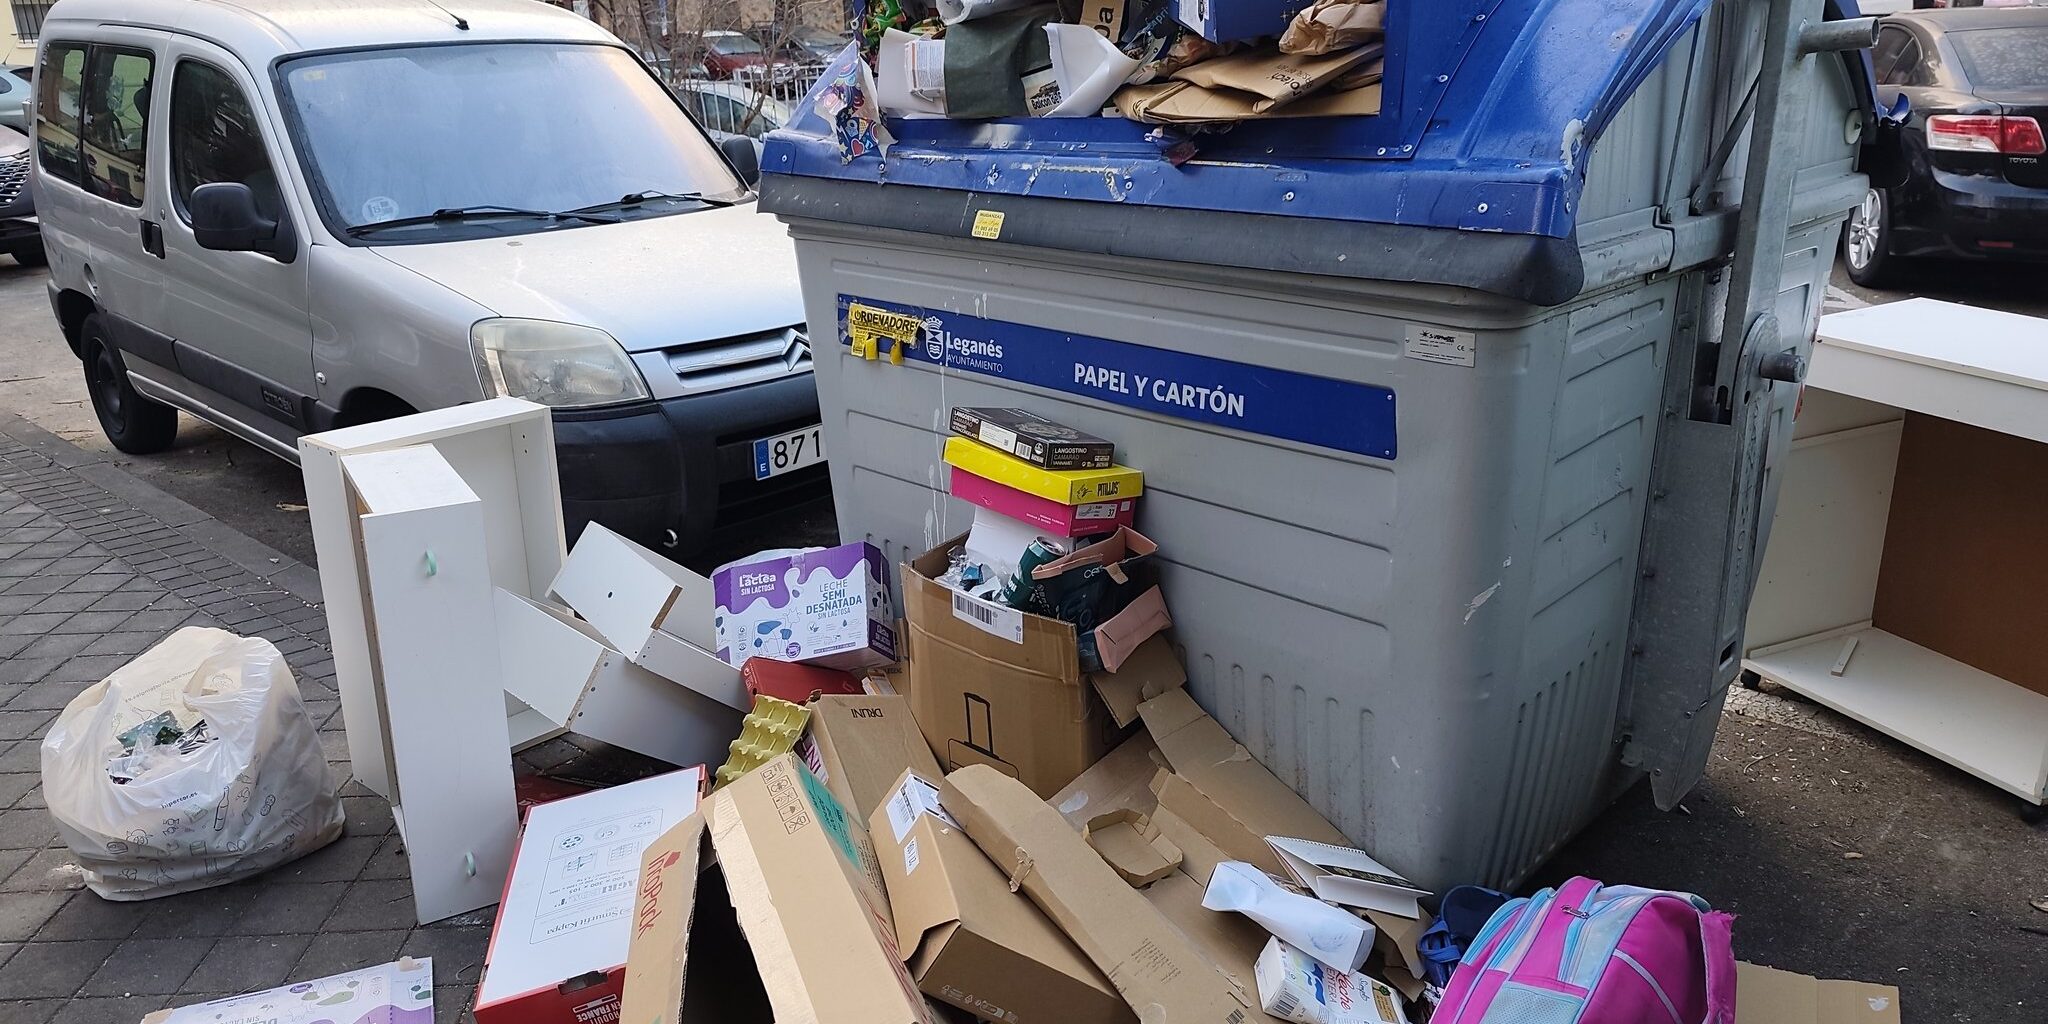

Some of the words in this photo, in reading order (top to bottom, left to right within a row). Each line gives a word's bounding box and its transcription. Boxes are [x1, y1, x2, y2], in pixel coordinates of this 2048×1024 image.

[947, 333, 1003, 358] Leganés
[947, 355, 1003, 373] AYUNTAMIENTO
[1074, 363, 1129, 394] PAPEL
[1134, 375, 1149, 397] Y
[1152, 380, 1244, 417] CARTÓN
[760, 463, 767, 472] E
[774, 430, 820, 469] 871
[1108, 509, 1115, 517] 37
[741, 587, 751, 596] SIN
[751, 584, 775, 594] LACTOSA
[819, 579, 848, 593] LECHE
[822, 589, 846, 602] SEMI
[806, 595, 863, 615] DESNATADA
[818, 611, 827, 620] SIN
[827, 608, 850, 619] LACTOSA
[851, 708, 883, 718] DRUNI
[547, 921, 577, 934] Kappa
[1327, 969, 1337, 1003] ENTERA
[576, 1005, 608, 1022] FRANCE
[591, 1010, 620, 1024] RODUIT
